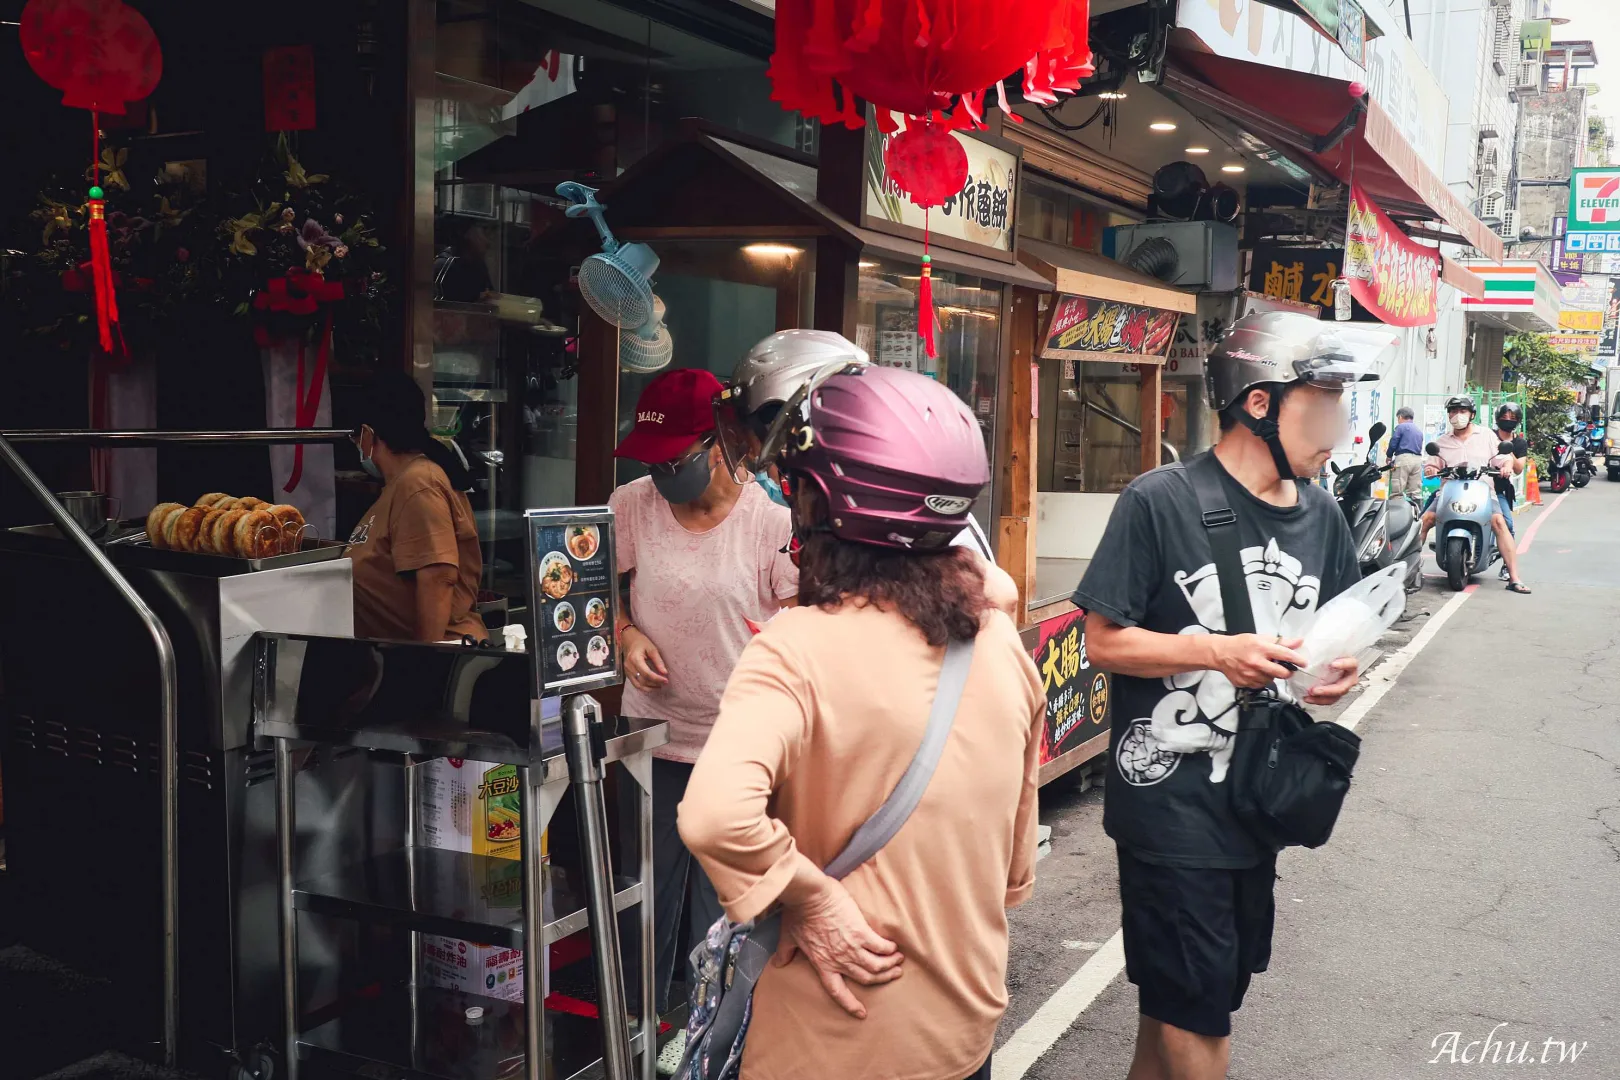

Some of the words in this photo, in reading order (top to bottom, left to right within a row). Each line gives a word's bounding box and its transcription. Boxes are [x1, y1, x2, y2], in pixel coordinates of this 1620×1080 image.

[1081, 302, 1150, 351] 大腸包小腸
[637, 410, 665, 424] MACE
[478, 776, 519, 799] 大豆沙
[424, 942, 467, 968] 壽耐炸油
